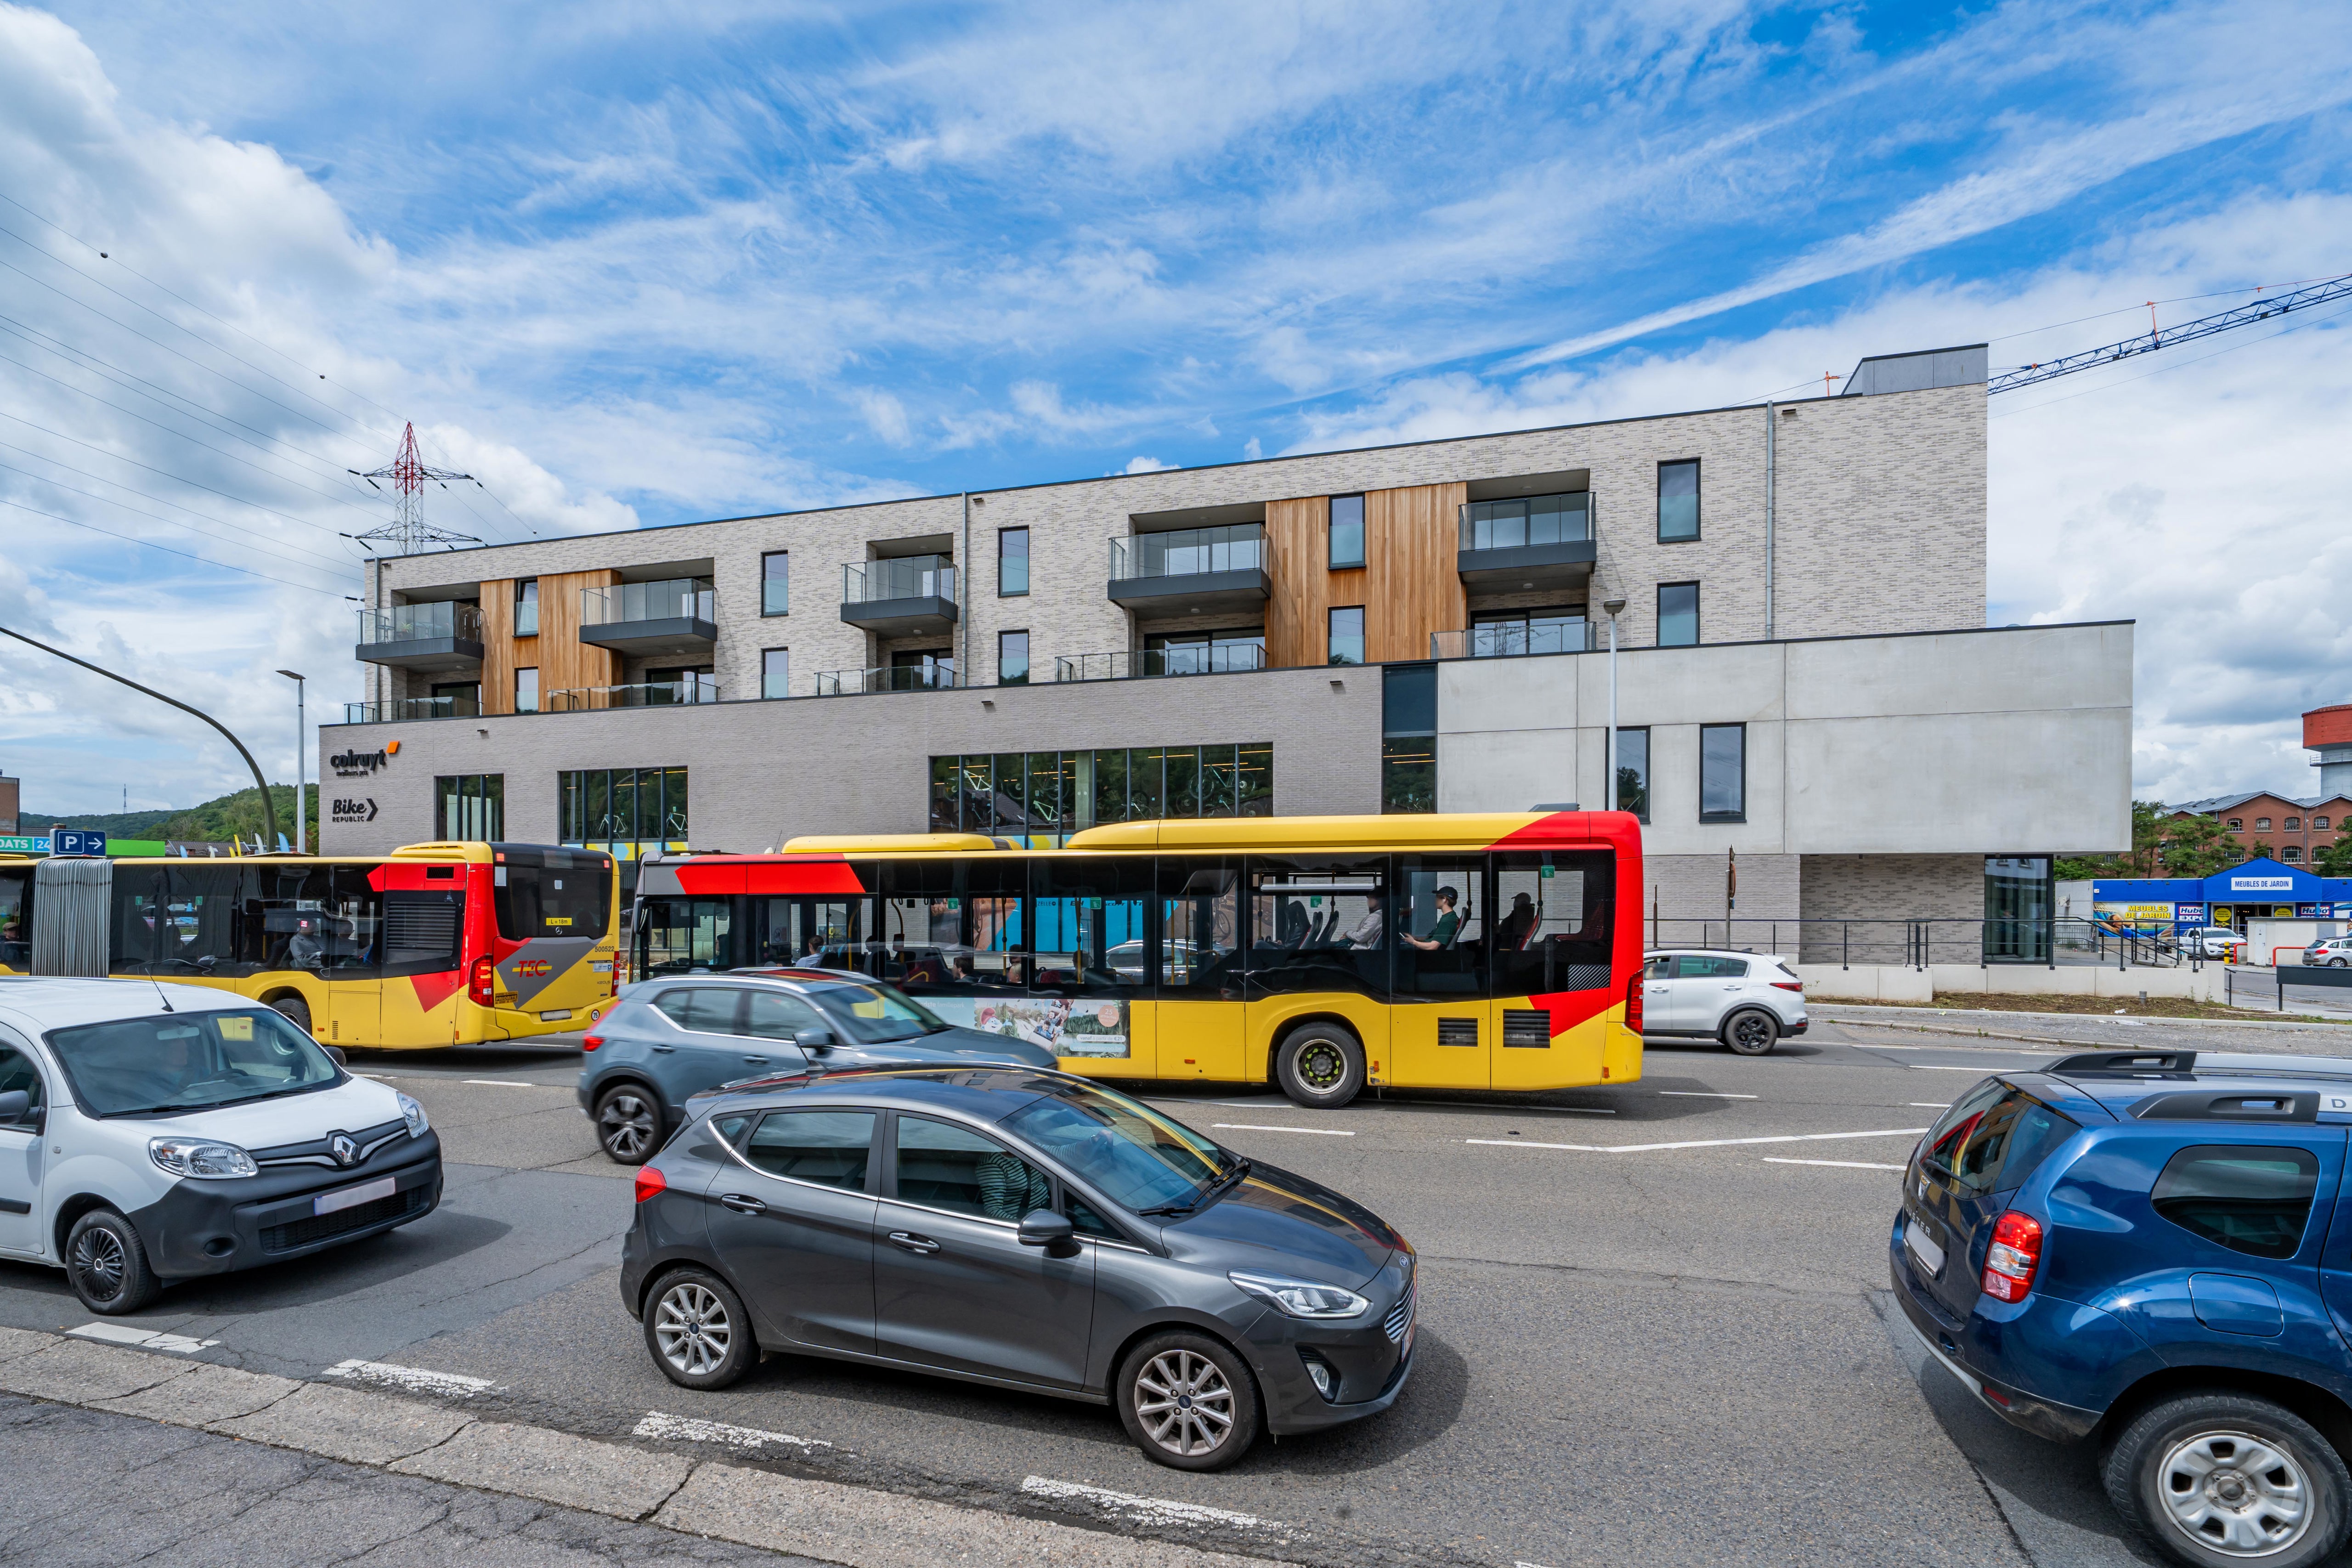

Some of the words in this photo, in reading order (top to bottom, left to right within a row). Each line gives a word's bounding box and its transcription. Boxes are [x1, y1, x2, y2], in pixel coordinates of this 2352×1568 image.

[330, 749, 385, 771] colruyt
[333, 799, 367, 814] Bike
[65, 836, 77, 849] P
[518, 959, 548, 978] TEC
[1906, 1203, 1931, 1237] DUSTER
